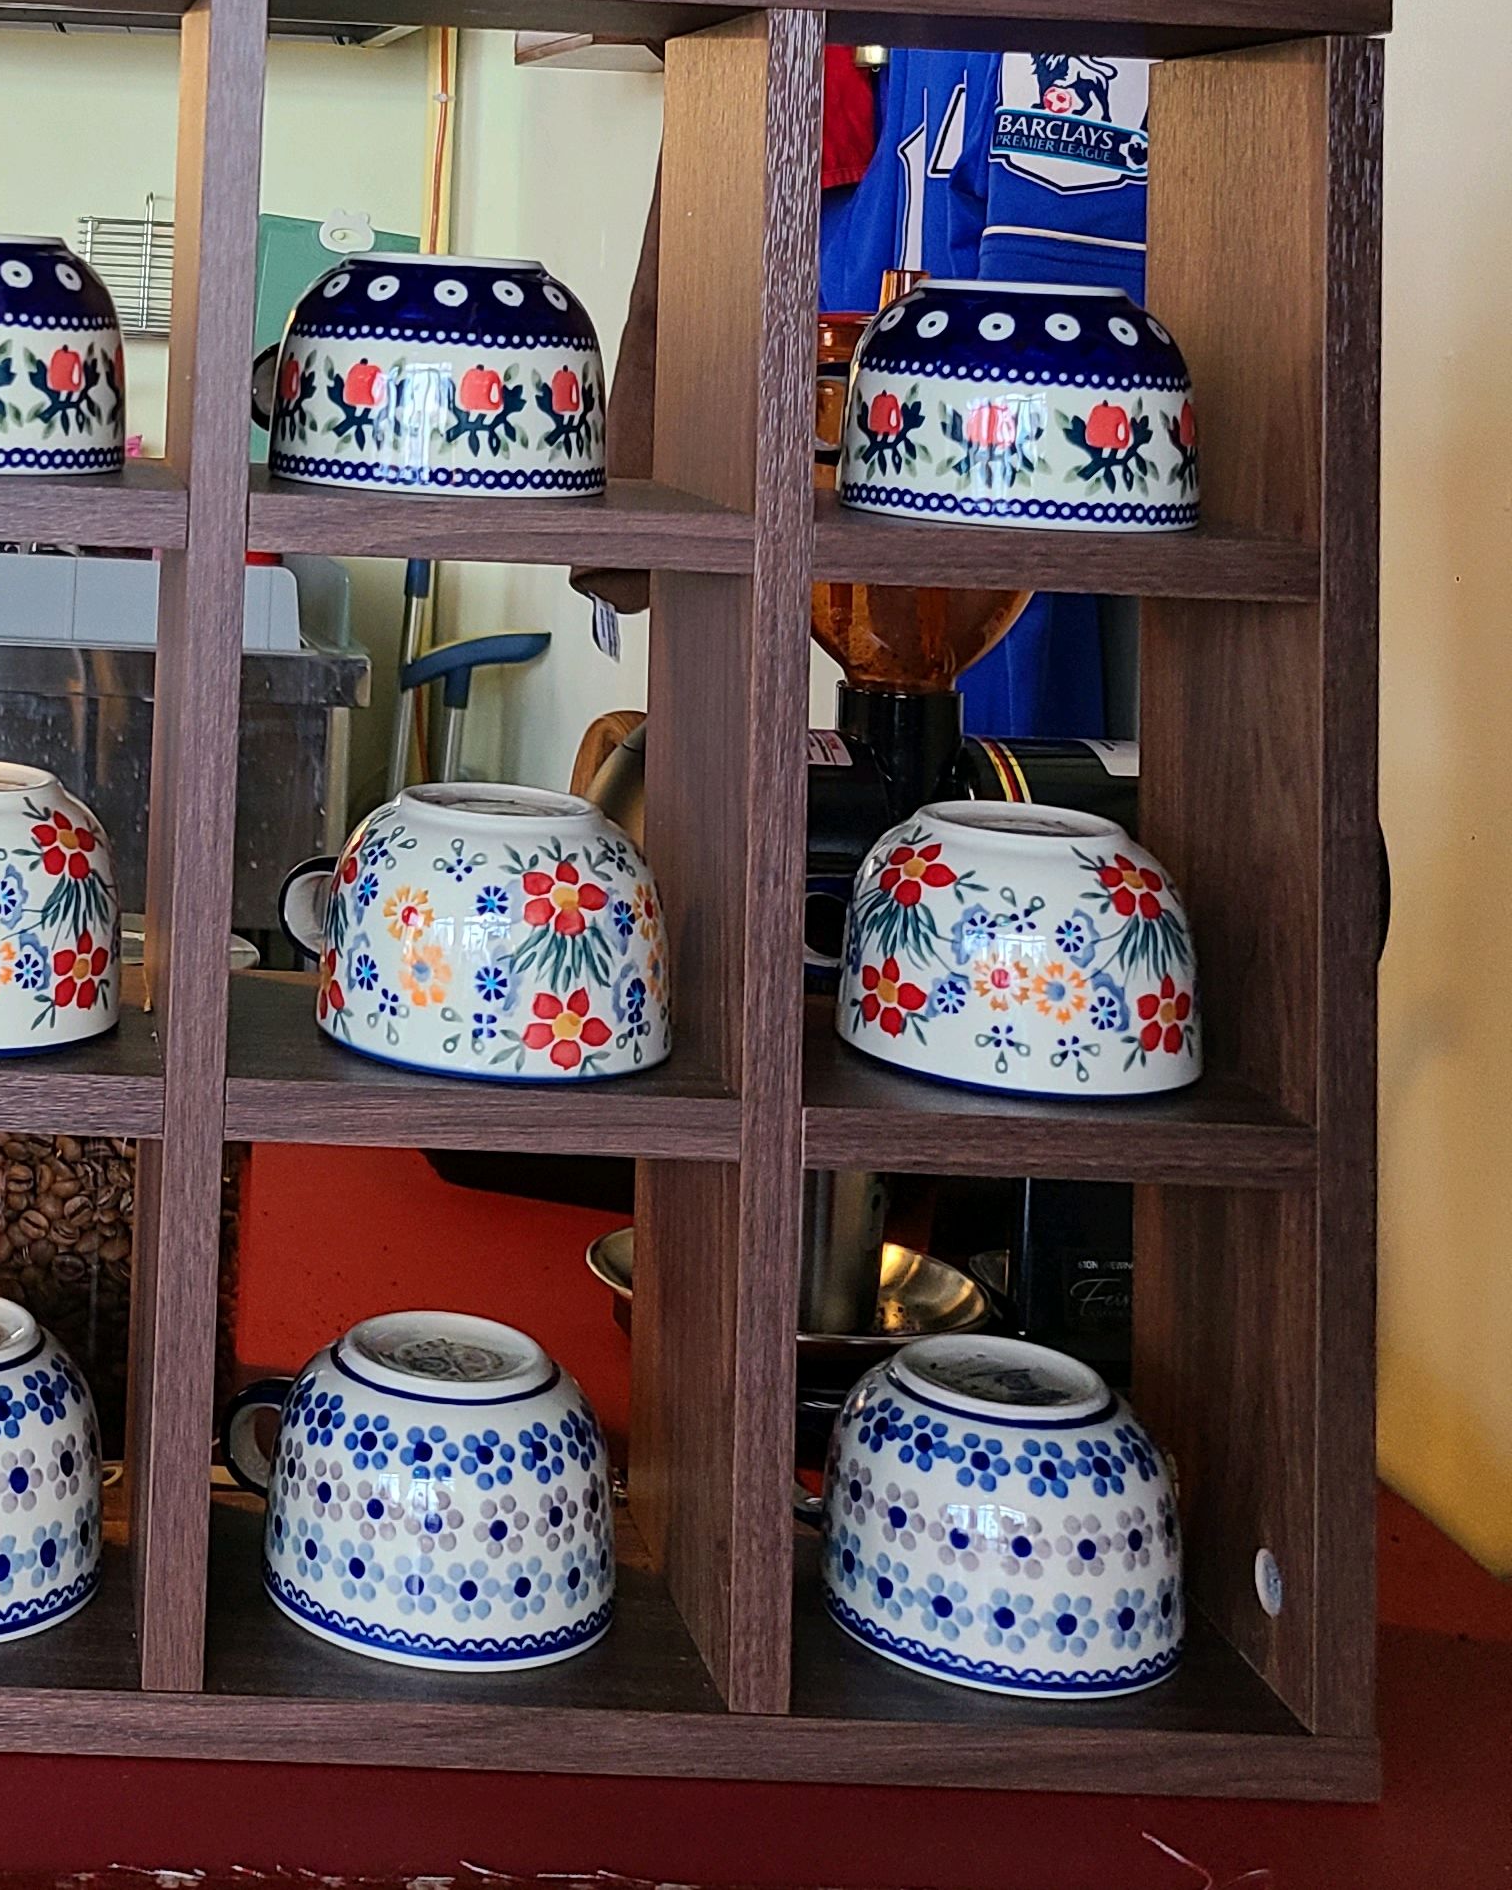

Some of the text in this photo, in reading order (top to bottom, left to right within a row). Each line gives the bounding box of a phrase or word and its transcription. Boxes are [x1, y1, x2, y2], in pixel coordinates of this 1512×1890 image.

[995, 134, 1111, 162] PREMIER LEAGUE
[998, 114, 1115, 150] BARCLAYS
